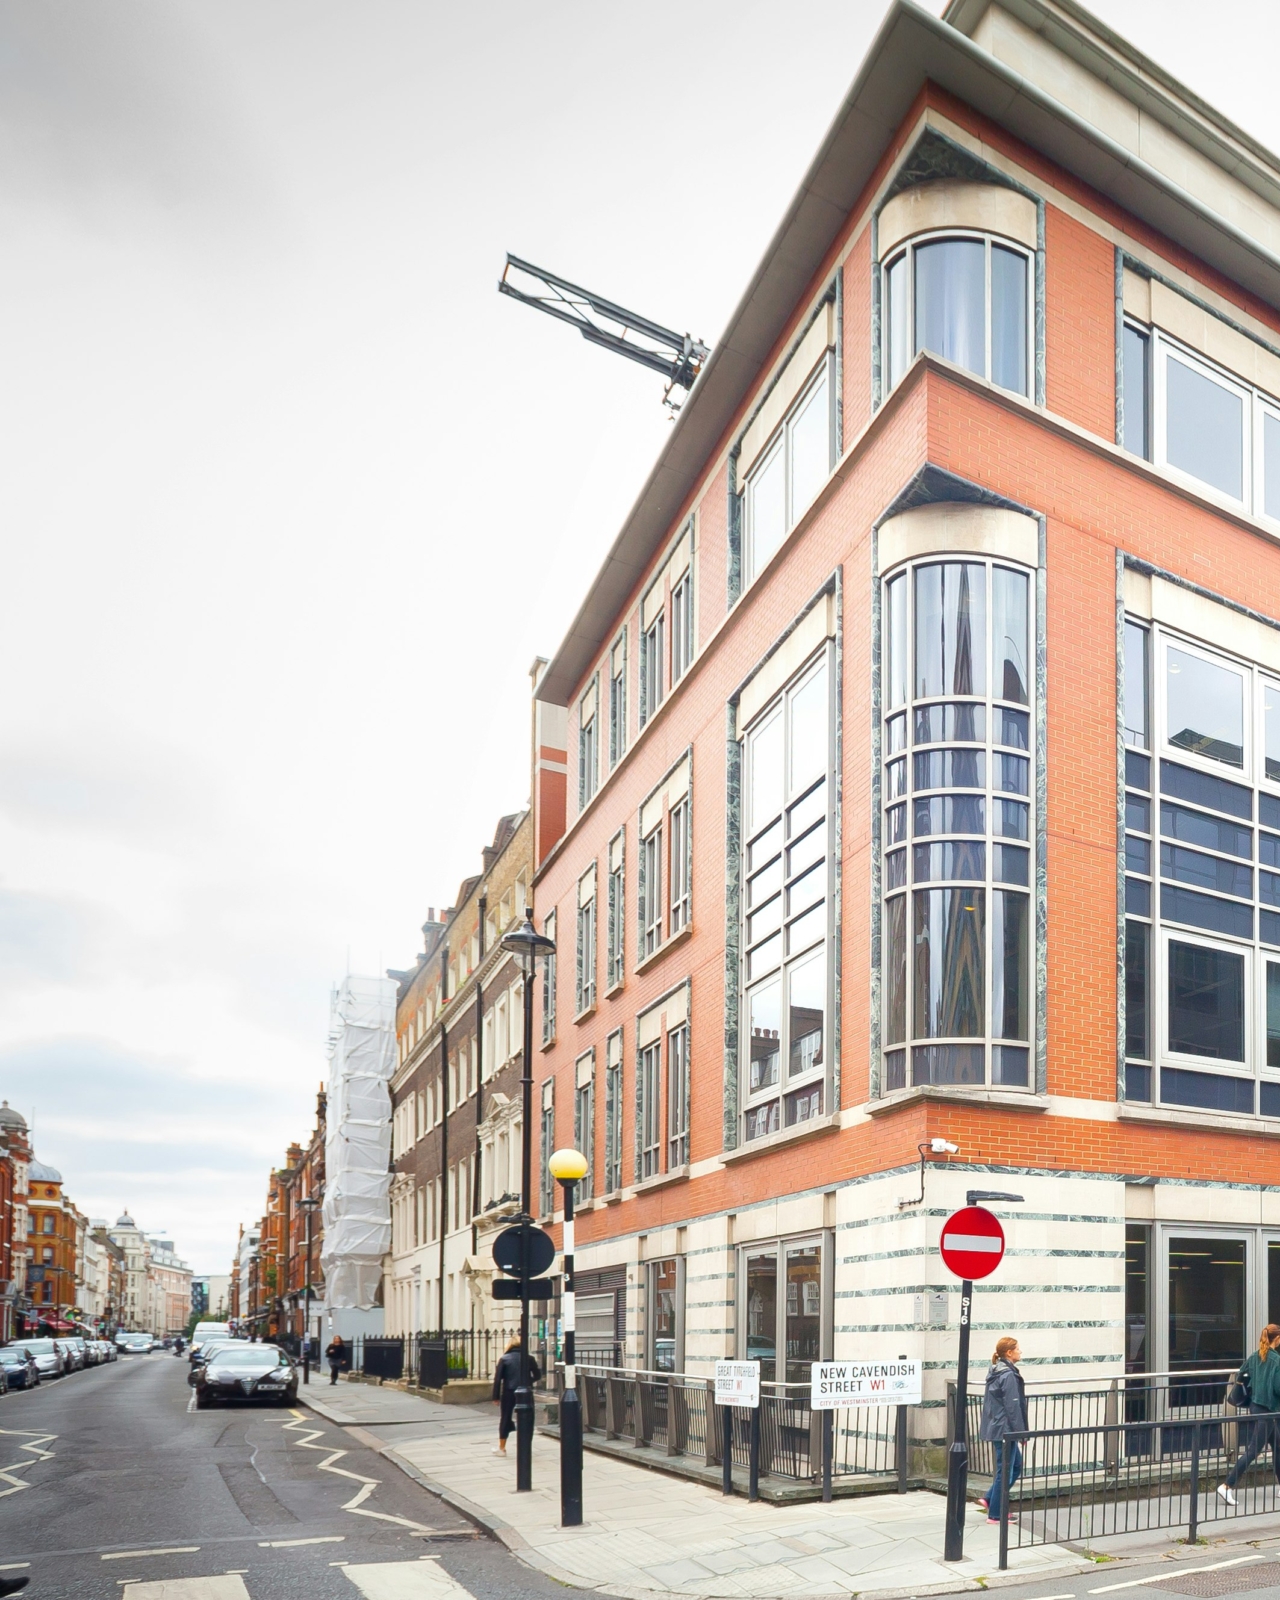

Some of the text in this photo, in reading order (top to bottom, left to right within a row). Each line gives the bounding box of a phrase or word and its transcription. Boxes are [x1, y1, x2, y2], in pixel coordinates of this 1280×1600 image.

[961, 1297, 970, 1325] S16
[820, 1364, 915, 1379] NEW CAVENDISH
[820, 1379, 885, 1394] STREET W1
[842, 1397, 878, 1405] WESTMINSTER
